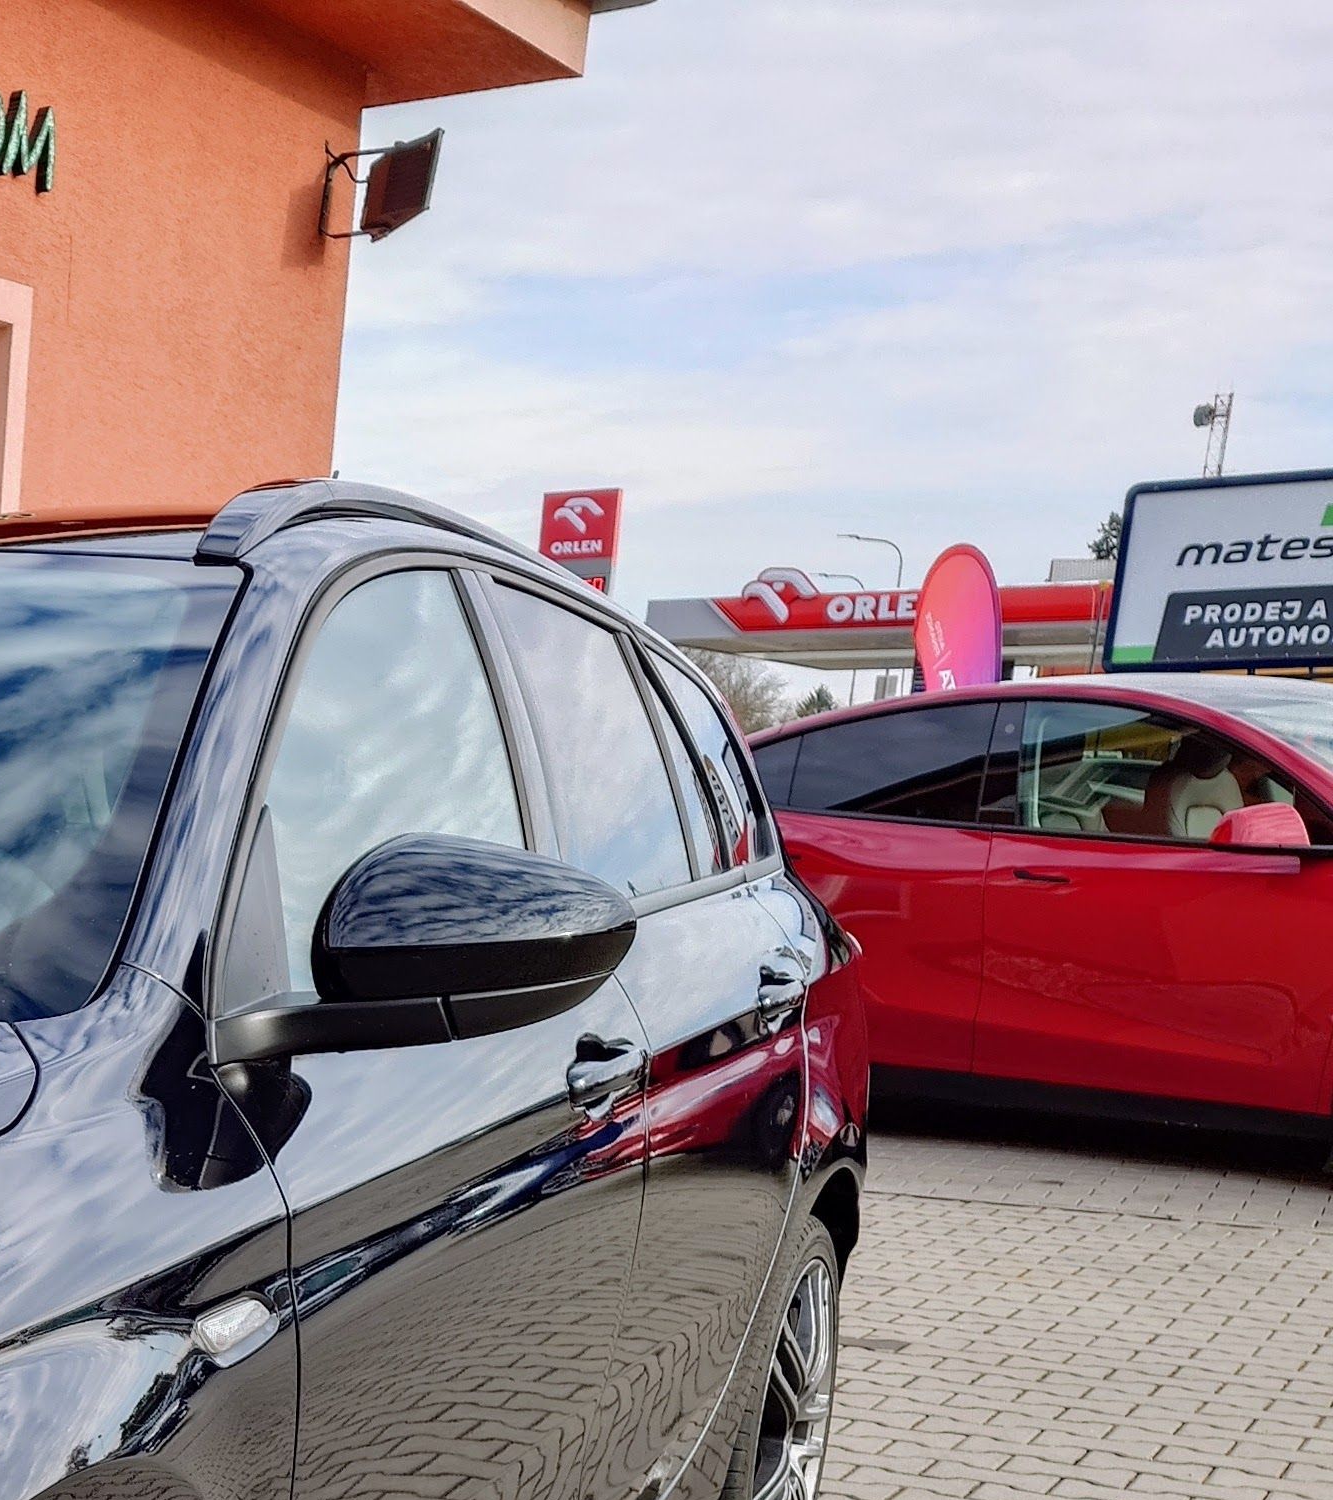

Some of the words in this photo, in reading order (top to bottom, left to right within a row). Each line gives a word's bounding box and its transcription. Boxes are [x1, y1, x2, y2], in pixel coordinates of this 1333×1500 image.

[549, 539, 603, 556] ORLEN
[1175, 533, 1333, 567] mates
[826, 593, 918, 623] ORLE
[1183, 599, 1303, 626] PRODEJ
[1307, 598, 1329, 621] A
[1204, 624, 1333, 649] AUTOMO
